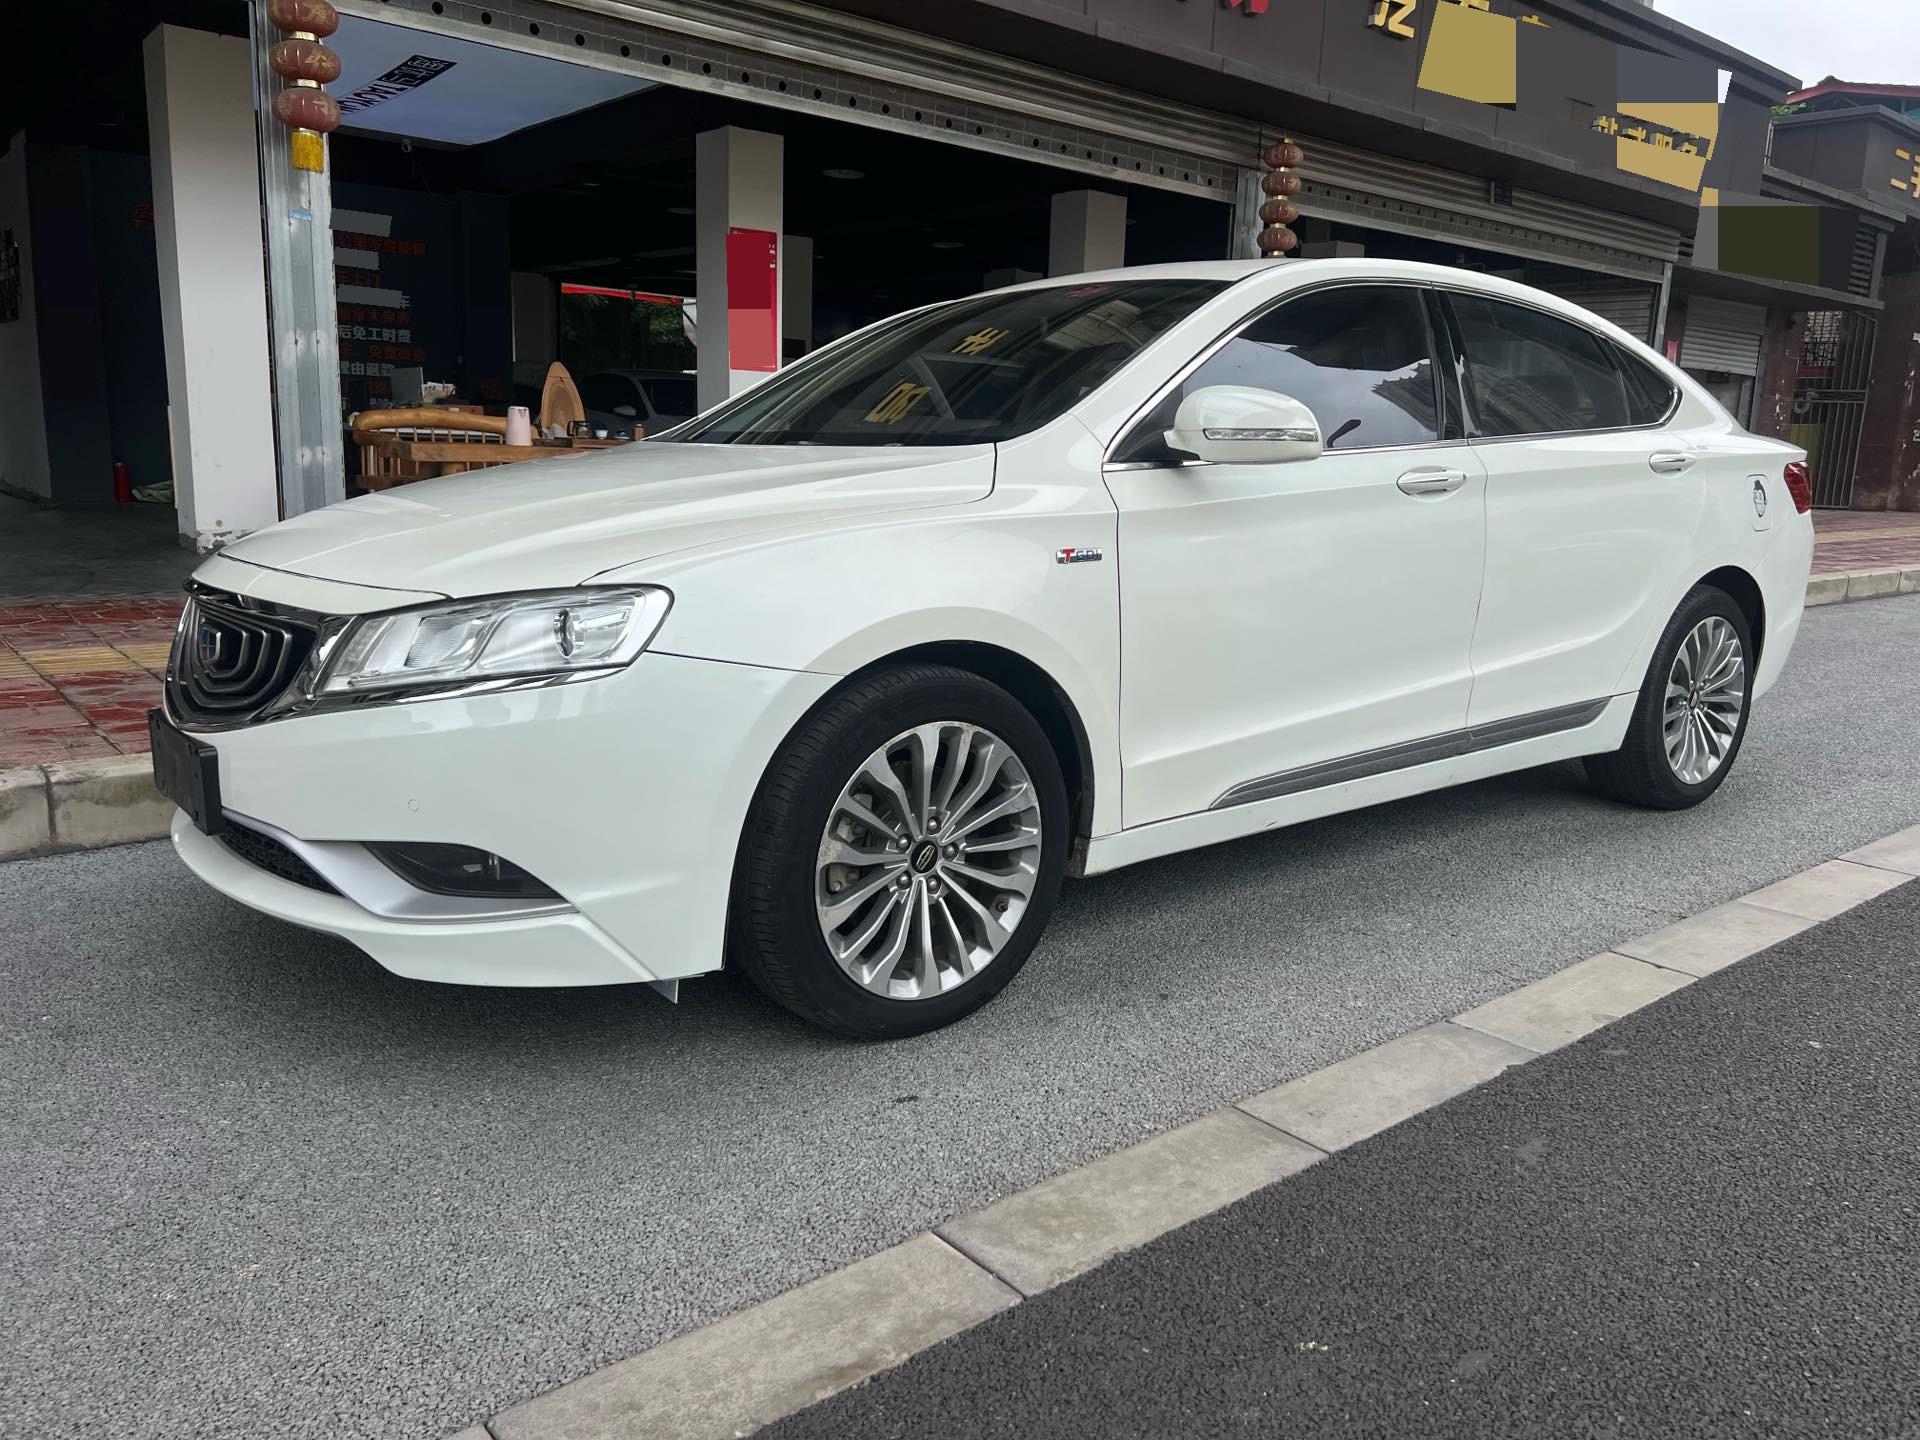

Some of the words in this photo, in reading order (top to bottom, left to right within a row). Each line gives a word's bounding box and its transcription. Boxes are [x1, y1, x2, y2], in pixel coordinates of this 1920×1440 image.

[338, 324, 412, 344] 后免工时费
